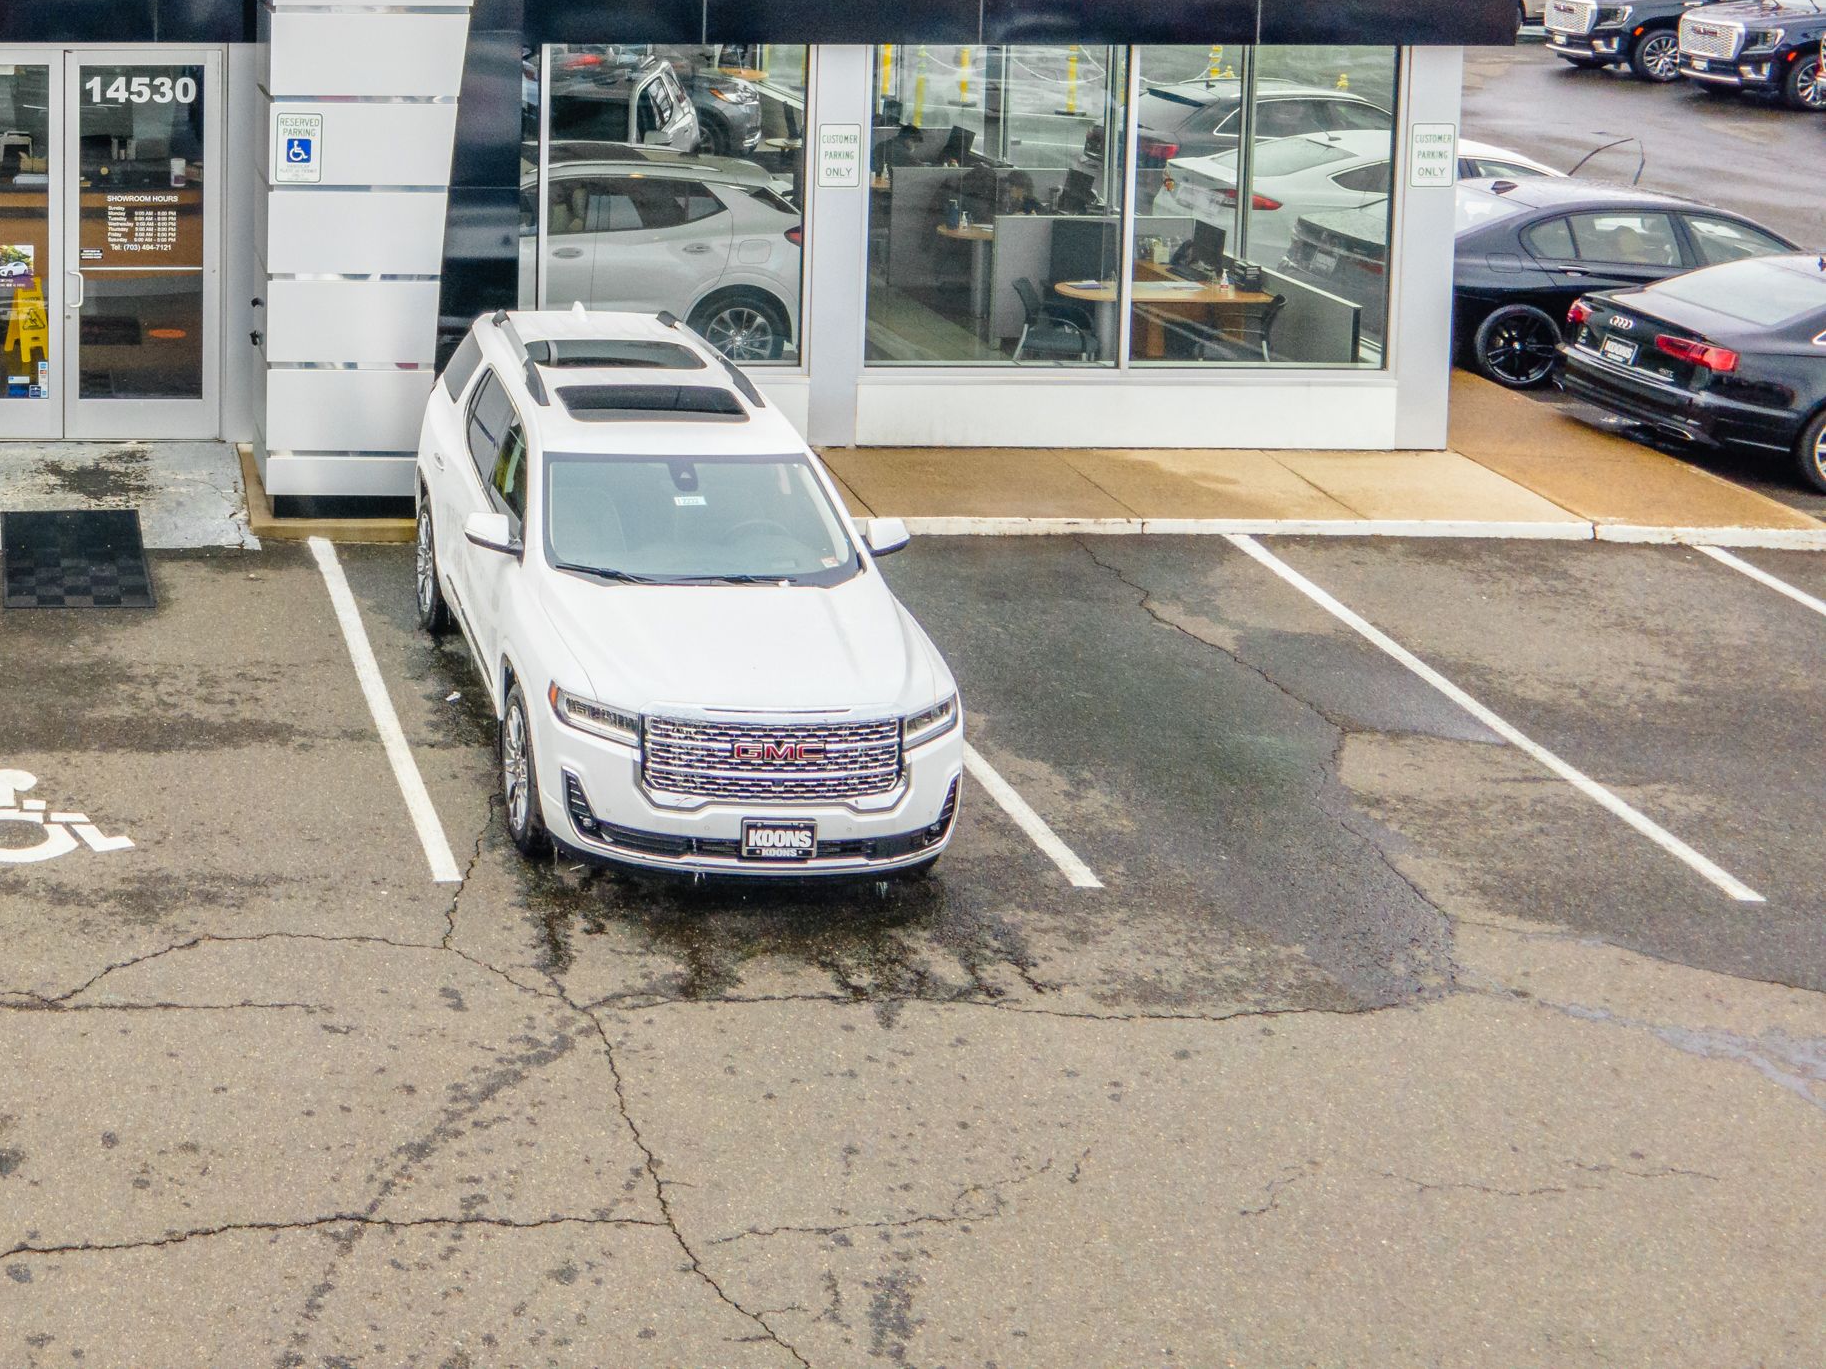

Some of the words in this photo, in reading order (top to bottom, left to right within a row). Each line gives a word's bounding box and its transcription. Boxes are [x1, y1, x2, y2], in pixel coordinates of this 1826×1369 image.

[85, 76, 197, 104] 14530
[279, 117, 320, 127] RESERVED
[283, 128, 316, 137] PARKING
[822, 134, 858, 144] CUSTOMER
[1415, 134, 1452, 144] CUSTOMER
[824, 150, 855, 160] PARKING
[1417, 150, 1448, 160] PARKING
[825, 167, 853, 177] ONLY
[1418, 167, 1446, 177] ONLY
[123, 243, 141, 251] (703)
[734, 741, 826, 761] GMC
[748, 829, 812, 848] KOONS
[761, 848, 798, 857] KOONS
